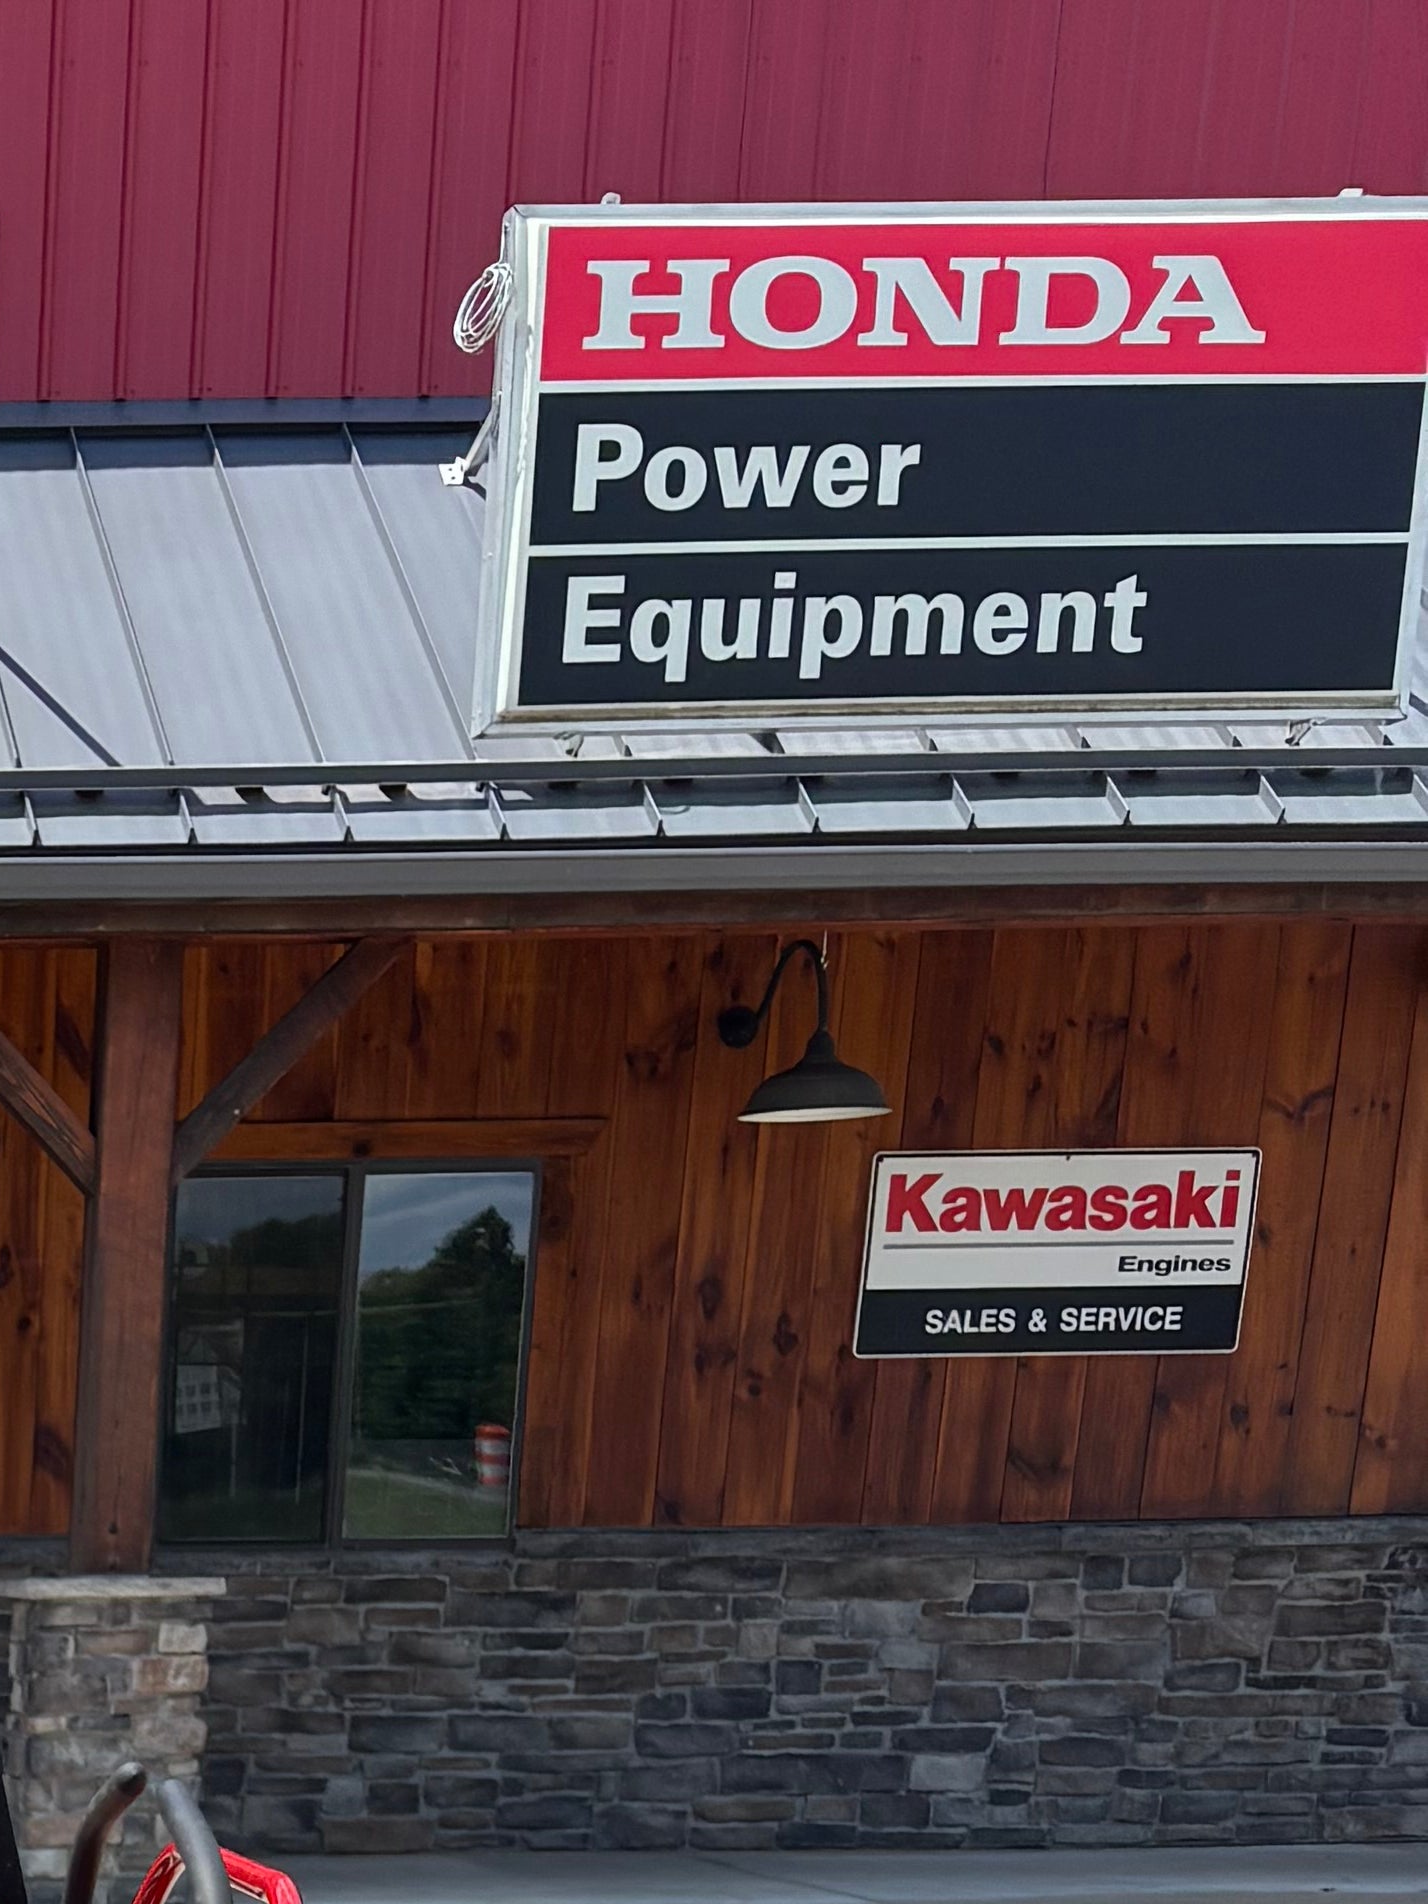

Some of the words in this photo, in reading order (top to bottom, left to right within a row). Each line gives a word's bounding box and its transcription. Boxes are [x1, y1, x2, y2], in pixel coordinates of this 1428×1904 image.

[581, 254, 1266, 349] HONDA
[571, 421, 923, 513] Power
[560, 566, 1148, 681] Equipment
[885, 1169, 1242, 1234] Kawasaki
[1117, 1255, 1232, 1276] Engines
[924, 1308, 1016, 1334] SALES
[1028, 1309, 1048, 1333] &
[1059, 1306, 1184, 1332] SERVICE
